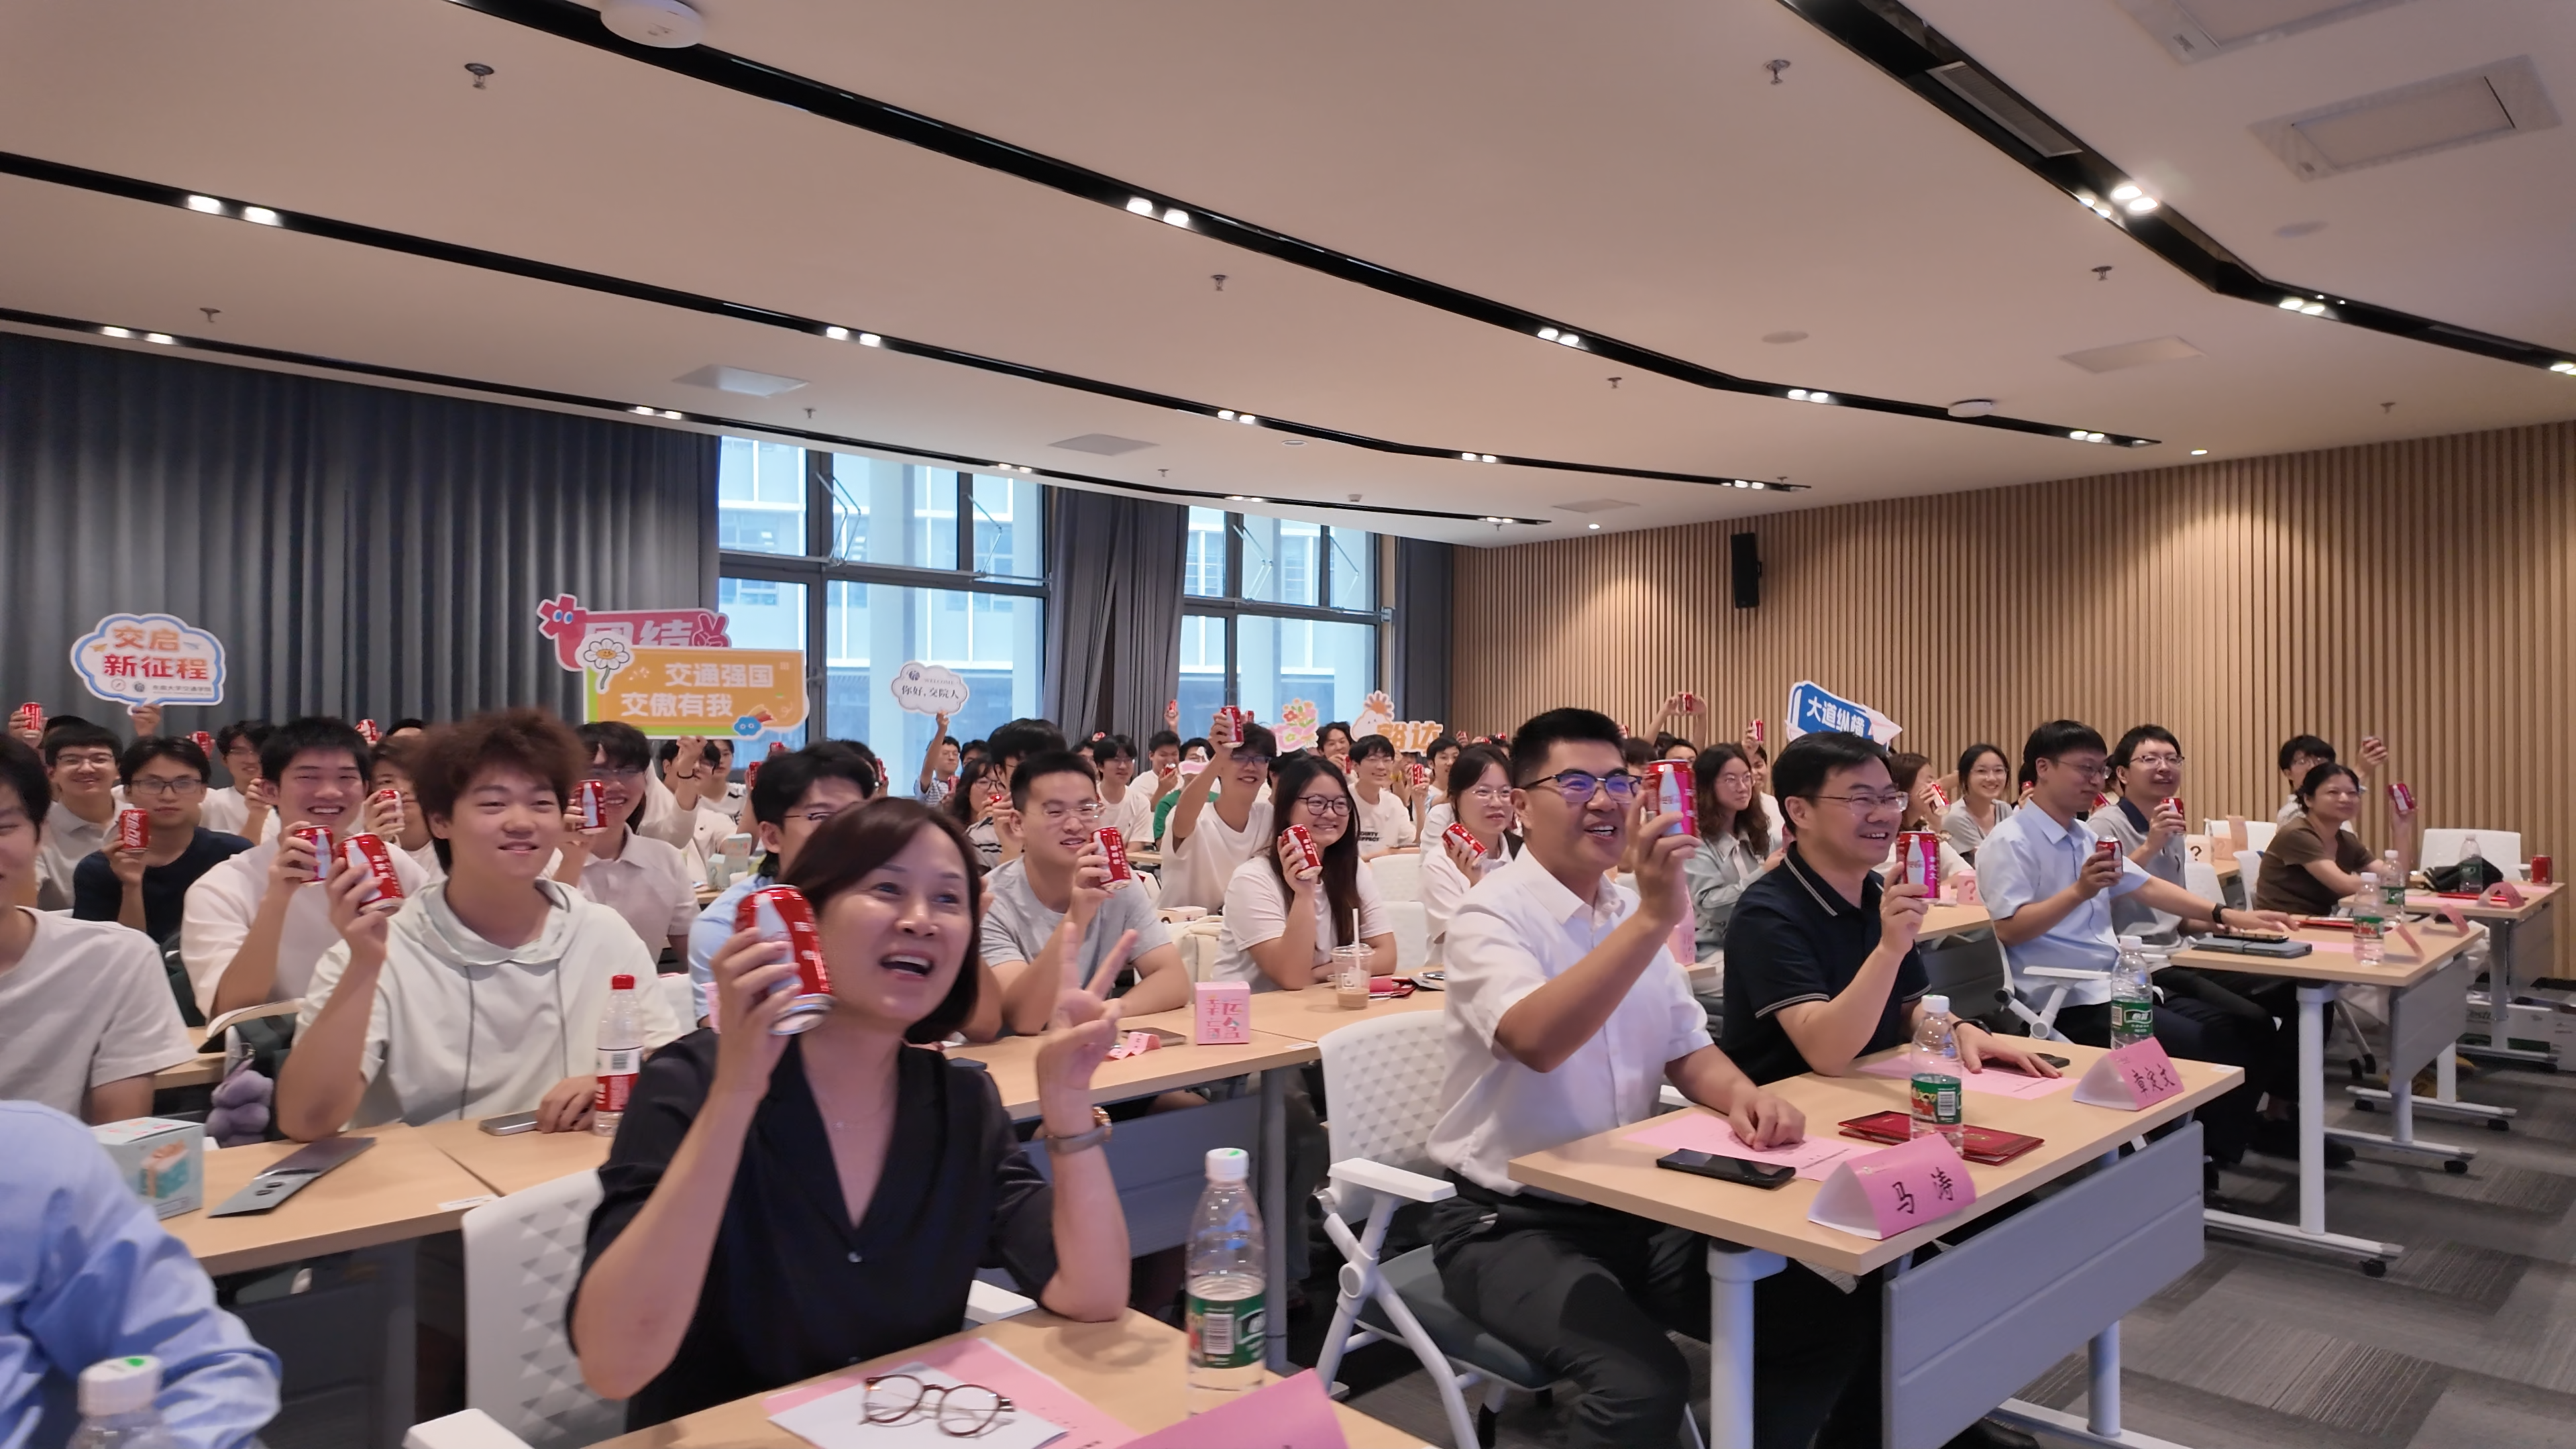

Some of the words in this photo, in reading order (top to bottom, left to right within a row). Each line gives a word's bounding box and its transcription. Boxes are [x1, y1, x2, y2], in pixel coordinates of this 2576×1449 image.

[113, 627, 180, 651] 交启
[104, 653, 209, 680] 新征程
[664, 662, 773, 688] 交通强国
[621, 692, 733, 717] 交傲有我
[1807, 695, 1865, 737] 大道纵横
[2190, 845, 2202, 861] ?
